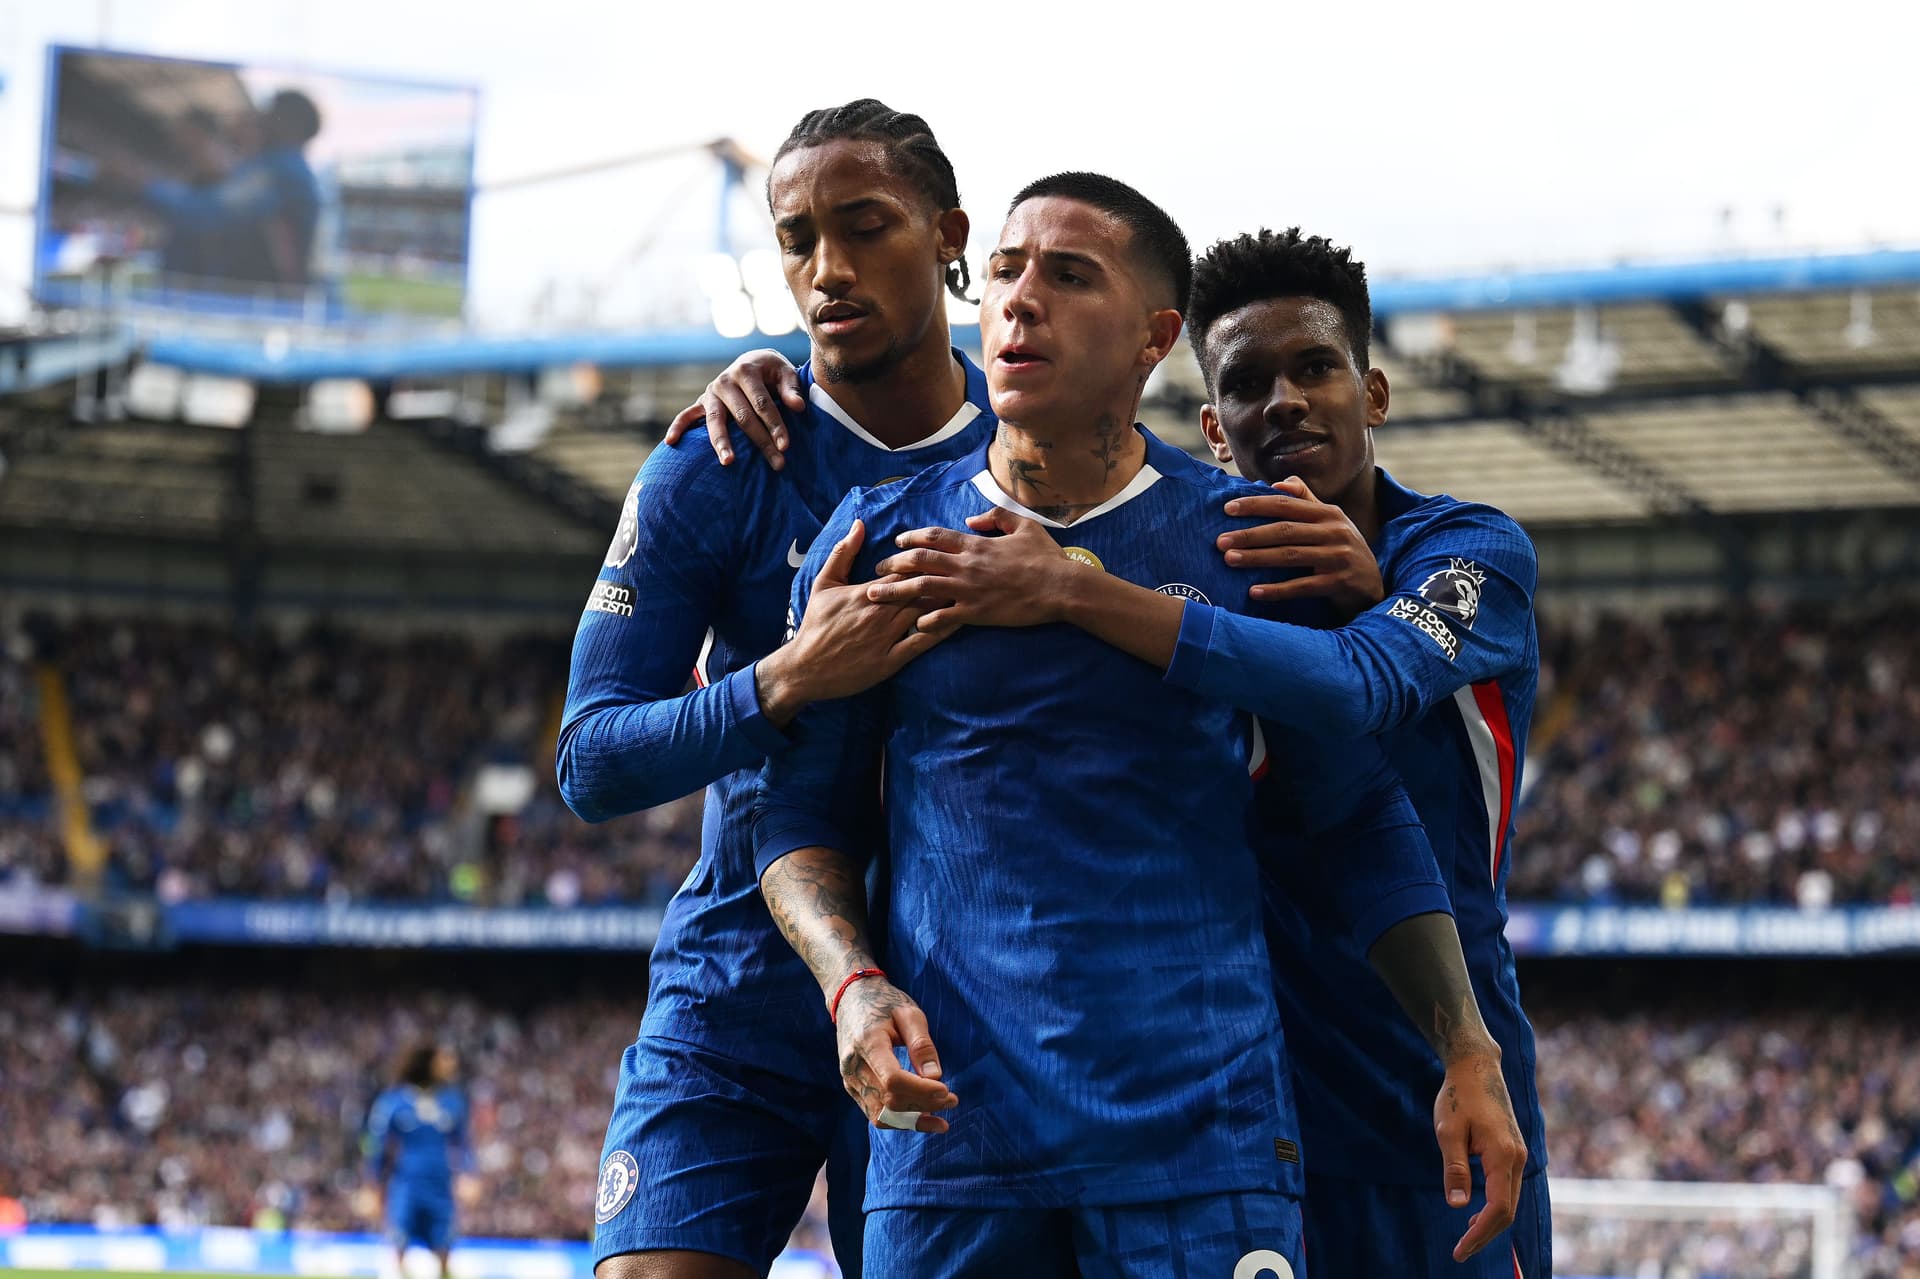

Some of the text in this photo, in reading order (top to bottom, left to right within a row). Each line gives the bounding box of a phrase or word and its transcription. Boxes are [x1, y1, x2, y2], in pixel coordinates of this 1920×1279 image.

[1066, 552, 1095, 567] AMP
[1159, 586, 1200, 603] HELSEA
[1386, 607, 1456, 662] for racism
[1393, 598, 1457, 647] No room
